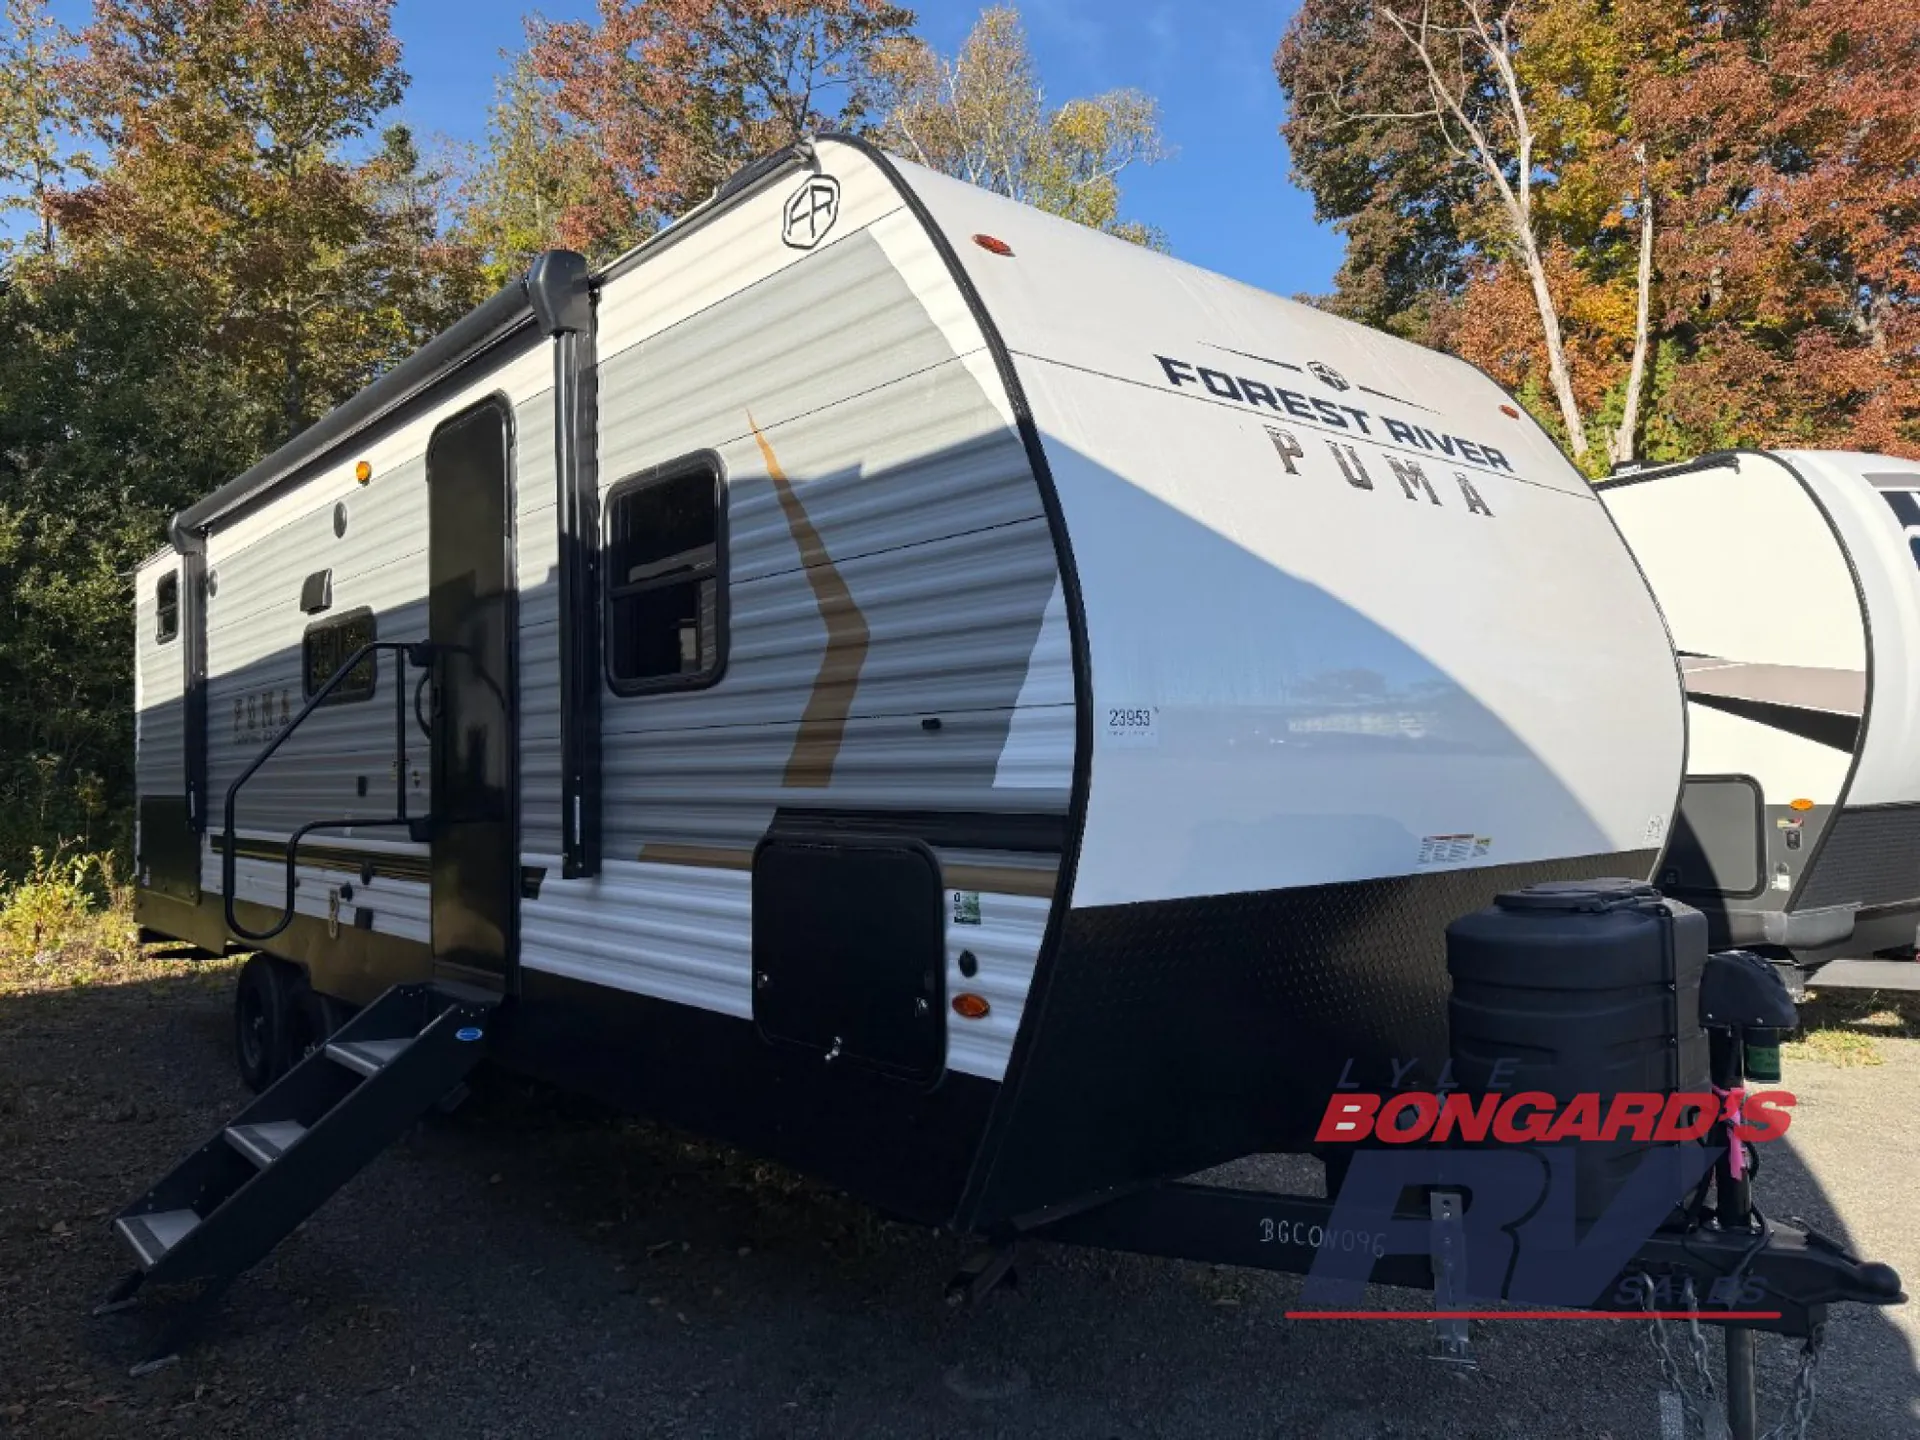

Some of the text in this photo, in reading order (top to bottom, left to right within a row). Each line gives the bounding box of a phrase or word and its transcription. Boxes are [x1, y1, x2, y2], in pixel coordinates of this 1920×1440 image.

[1153, 354, 1515, 472] FOREST RIVER
[1263, 424, 1496, 518] PUMA
[1109, 708, 1151, 727] 23953
